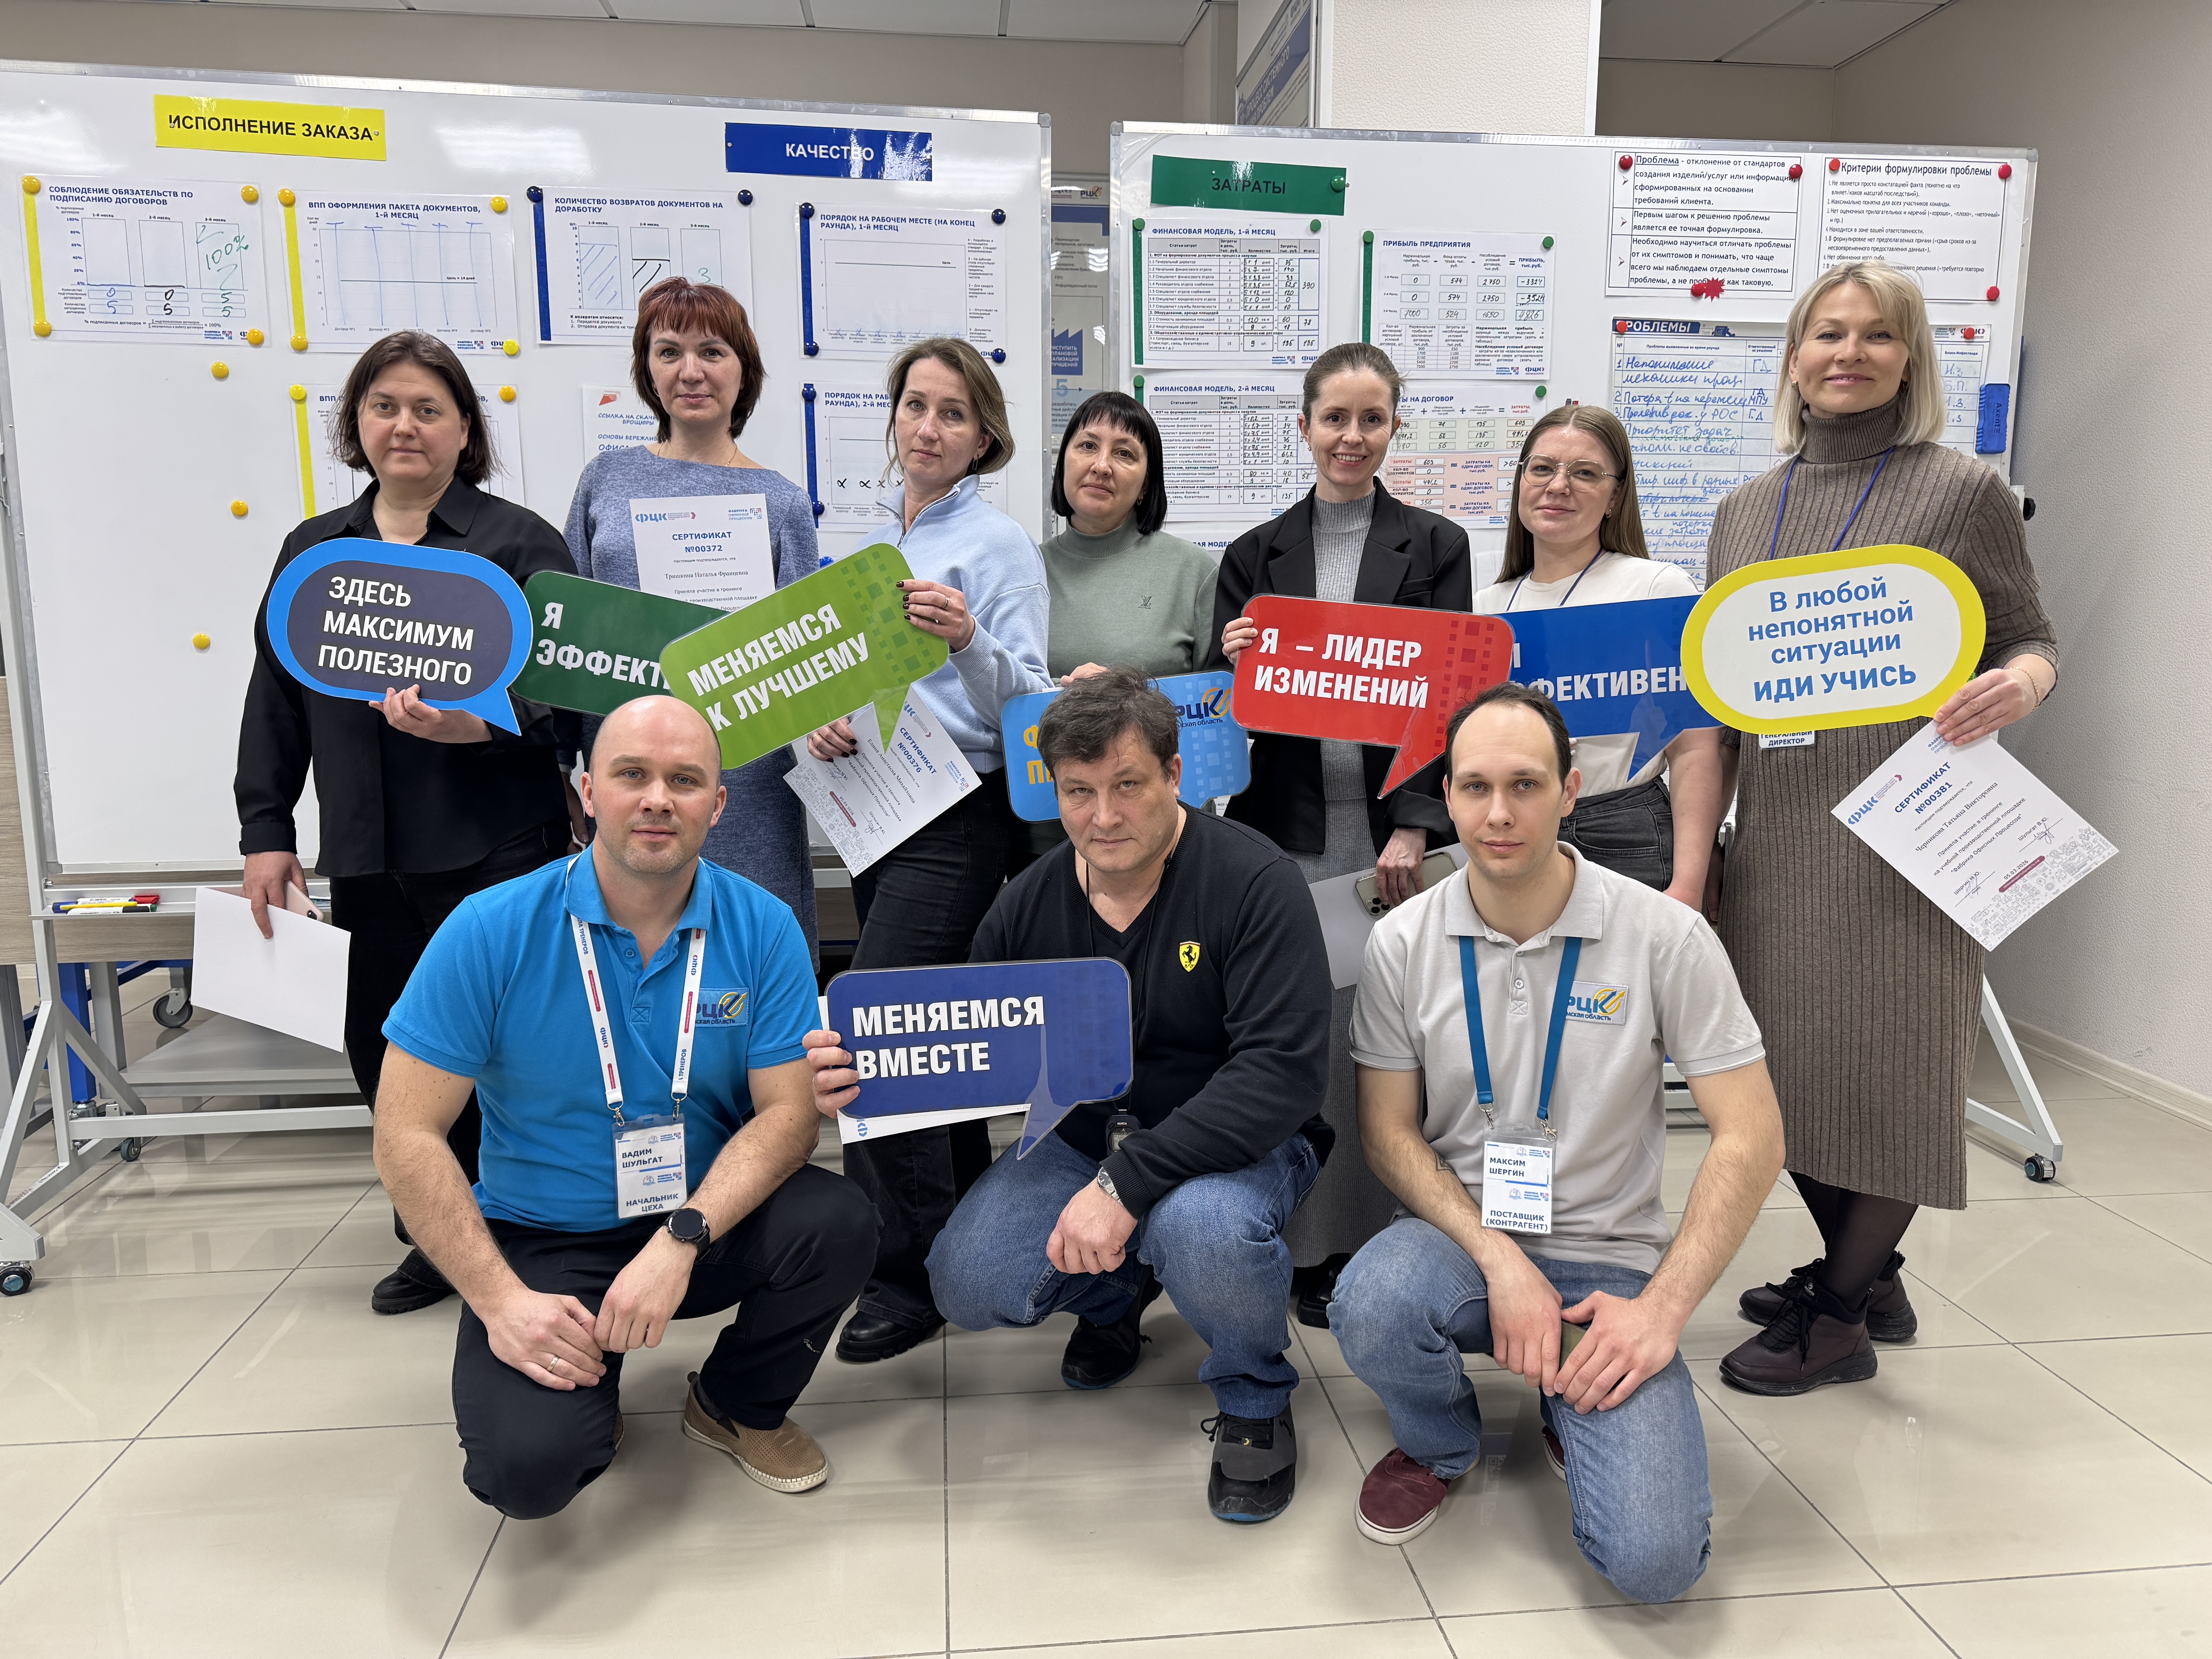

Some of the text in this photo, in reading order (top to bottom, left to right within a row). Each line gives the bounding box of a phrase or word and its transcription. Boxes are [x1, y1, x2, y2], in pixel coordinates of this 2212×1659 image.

[169, 115, 373, 141] ИСПОЛНЕНИЕ ЗАКАЗА
[786, 142, 874, 162] КАЧЕСТВО
[1673, 172, 1728, 180] изделий/услуг
[1842, 163, 1991, 177] Критерии формулировки проблемы
[49, 186, 109, 194] СОБЛЮДЕНИЕ
[112, 189, 178, 197] ОБЯЗАТЕЛЬСТВ
[1212, 175, 1285, 194] ЗАТРАТЫ
[1635, 184, 1700, 192] сформированных
[1633, 238, 1678, 246] Необходимо
[1707, 225, 1762, 234] формулировка.
[698, 268, 711, 283] 3
[165, 289, 174, 301] 0
[221, 292, 232, 303] 5
[1617, 321, 1691, 333] РОБЛЕМЫ
[1056, 379, 1068, 397] 5
[672, 532, 732, 540] СЕРТИФИКАТ
[329, 577, 410, 606] ЗДЕСЬ
[1770, 576, 1886, 612] В любой
[541, 603, 563, 629] Я
[1749, 594, 1913, 641] непонятной
[324, 611, 473, 650] МАКСИМУМ
[686, 603, 843, 696] МЕНЯЕМСЯ
[1259, 628, 1279, 654] Я
[1322, 634, 1421, 670] ЛИДЕР
[1772, 634, 1900, 664] ситуации
[318, 645, 471, 685] ПОЛЕЗНОГО
[536, 638, 671, 690] ЭФФЕКТ
[705, 632, 870, 732] К ЛУЧШЕМУ
[1255, 665, 1428, 708] ИЗМЕНЕНИЙ
[1754, 665, 1916, 703] ИДИ УЧИСЬ
[900, 727, 937, 775] СЕРТИФИКАТ
[1769, 738, 1804, 746] ДИРЕКТОР
[898, 742, 922, 773] №00376
[1894, 762, 1951, 812] СЕРТИФИКАТ
[1915, 782, 1953, 814] №00381
[1942, 782, 1998, 827] Татьяна Викторовна
[1938, 802, 2002, 857] Приняла участие тренинге
[1940, 799, 2025, 870] учебной площадке
[1973, 837, 1995, 855] Офисных
[579, 928, 588, 954] ТРЕНЕРОВ
[853, 996, 1044, 1036] МЕНЯЕМСЯ
[855, 1042, 990, 1080] ВМЕСТЕ
[622, 1149, 651, 1158] ВАДИМ
[623, 1157, 663, 1168] ШУЛЬГАТ
[1490, 1158, 1525, 1166] МАКСИМ
[1490, 1168, 1524, 1176] ШЕРГИН
[627, 1194, 678, 1208] НАЧАЛЬНИК
[1486, 1218, 1548, 1232] (КОНТРАГЕНТ)
[1490, 1211, 1544, 1224] ПОСТАВЩИК
